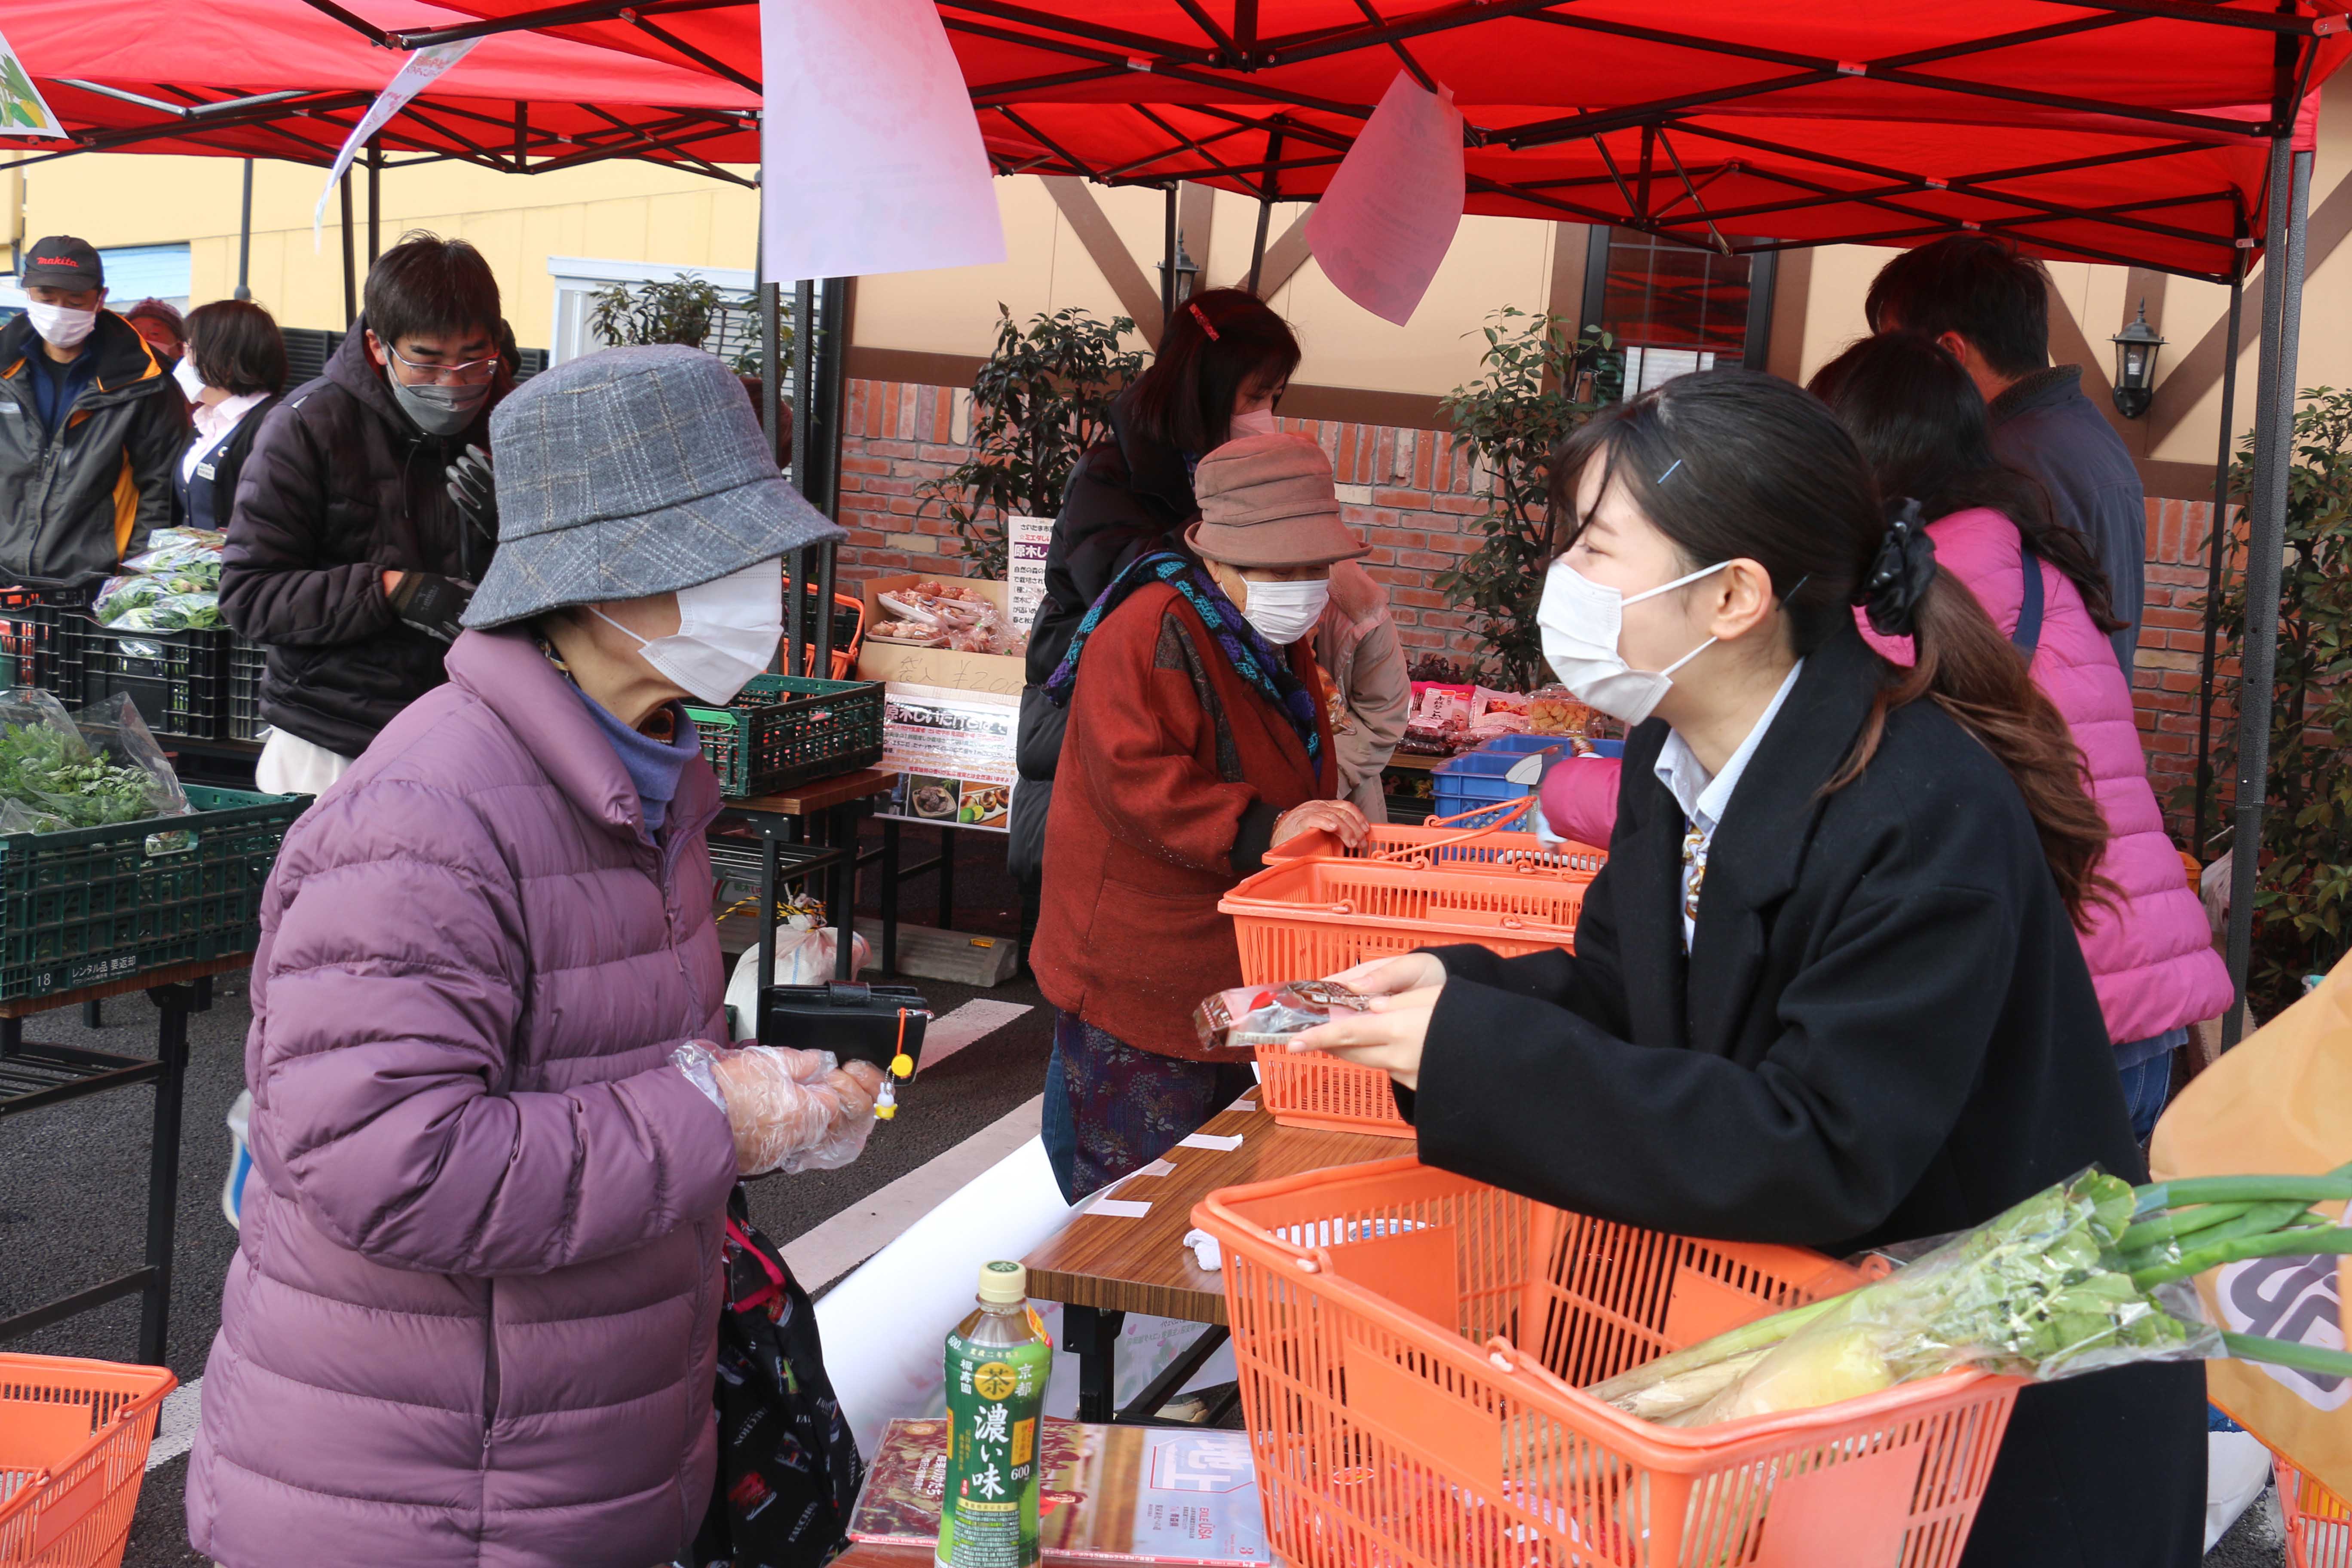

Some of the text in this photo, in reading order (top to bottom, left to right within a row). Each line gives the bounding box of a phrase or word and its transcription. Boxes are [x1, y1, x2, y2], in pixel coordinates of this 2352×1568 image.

[37, 256, 79, 267] makita
[72, 961, 108, 977] レンタル品
[110, 956, 136, 971] 要返却
[38, 973, 51, 986] 18
[947, 1335, 962, 1350] 600
[982, 1368, 1011, 1395] 茶
[1014, 1363, 1033, 1396] 京都
[972, 1403, 1010, 1500] 濃い味
[1011, 1464, 1030, 1481] 600
[1199, 1507, 1209, 1522] EXILE
